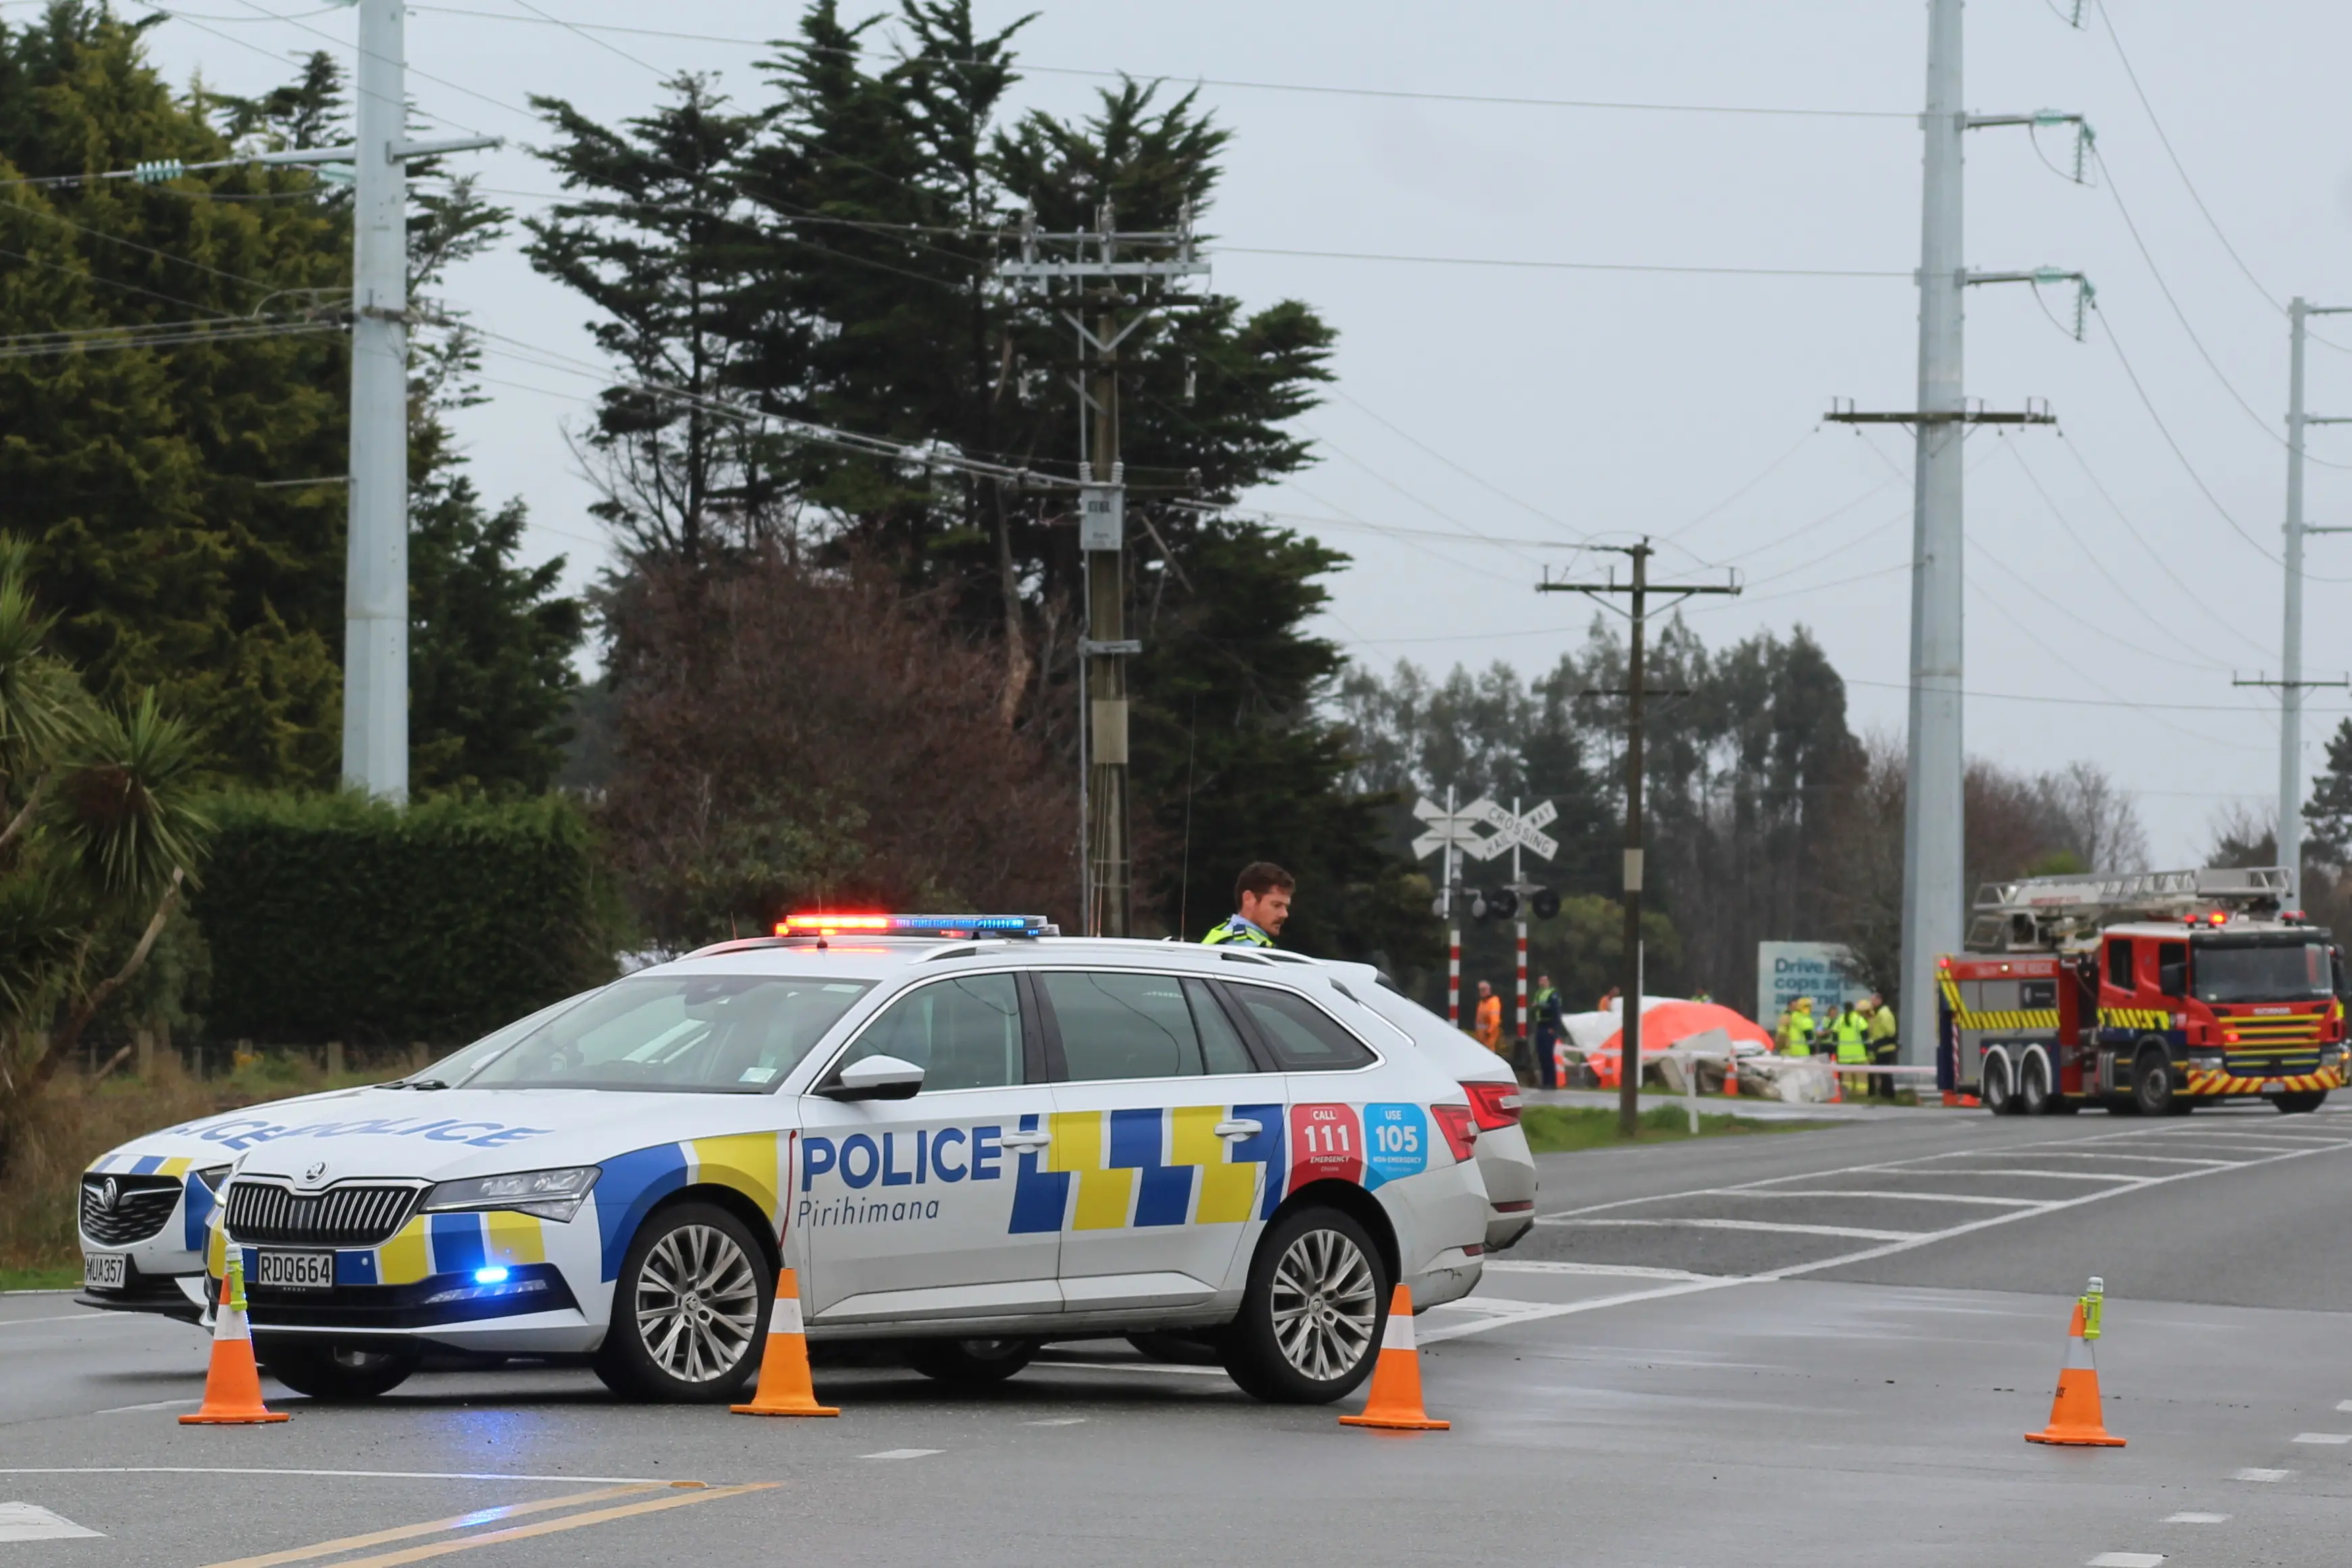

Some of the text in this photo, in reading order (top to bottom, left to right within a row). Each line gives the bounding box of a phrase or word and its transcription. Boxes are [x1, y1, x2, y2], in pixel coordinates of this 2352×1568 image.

[1530, 805, 1552, 826] WAY
[1488, 807, 1551, 854] CROSSING
[1775, 957, 1825, 974] Drive
[1774, 978, 1820, 992] cops
[1312, 1109, 1337, 1120] CALL
[1385, 1110, 1402, 1120] USE
[263, 1116, 556, 1148] POLICE
[1305, 1124, 1349, 1152] 111
[1376, 1124, 1418, 1153] 105
[802, 1126, 1002, 1192] POLICE
[1309, 1155, 1351, 1164] EMERGENCY
[797, 1196, 940, 1228] Pirihimana
[86, 1258, 124, 1282] MUA357
[261, 1256, 330, 1283] RDQ664
